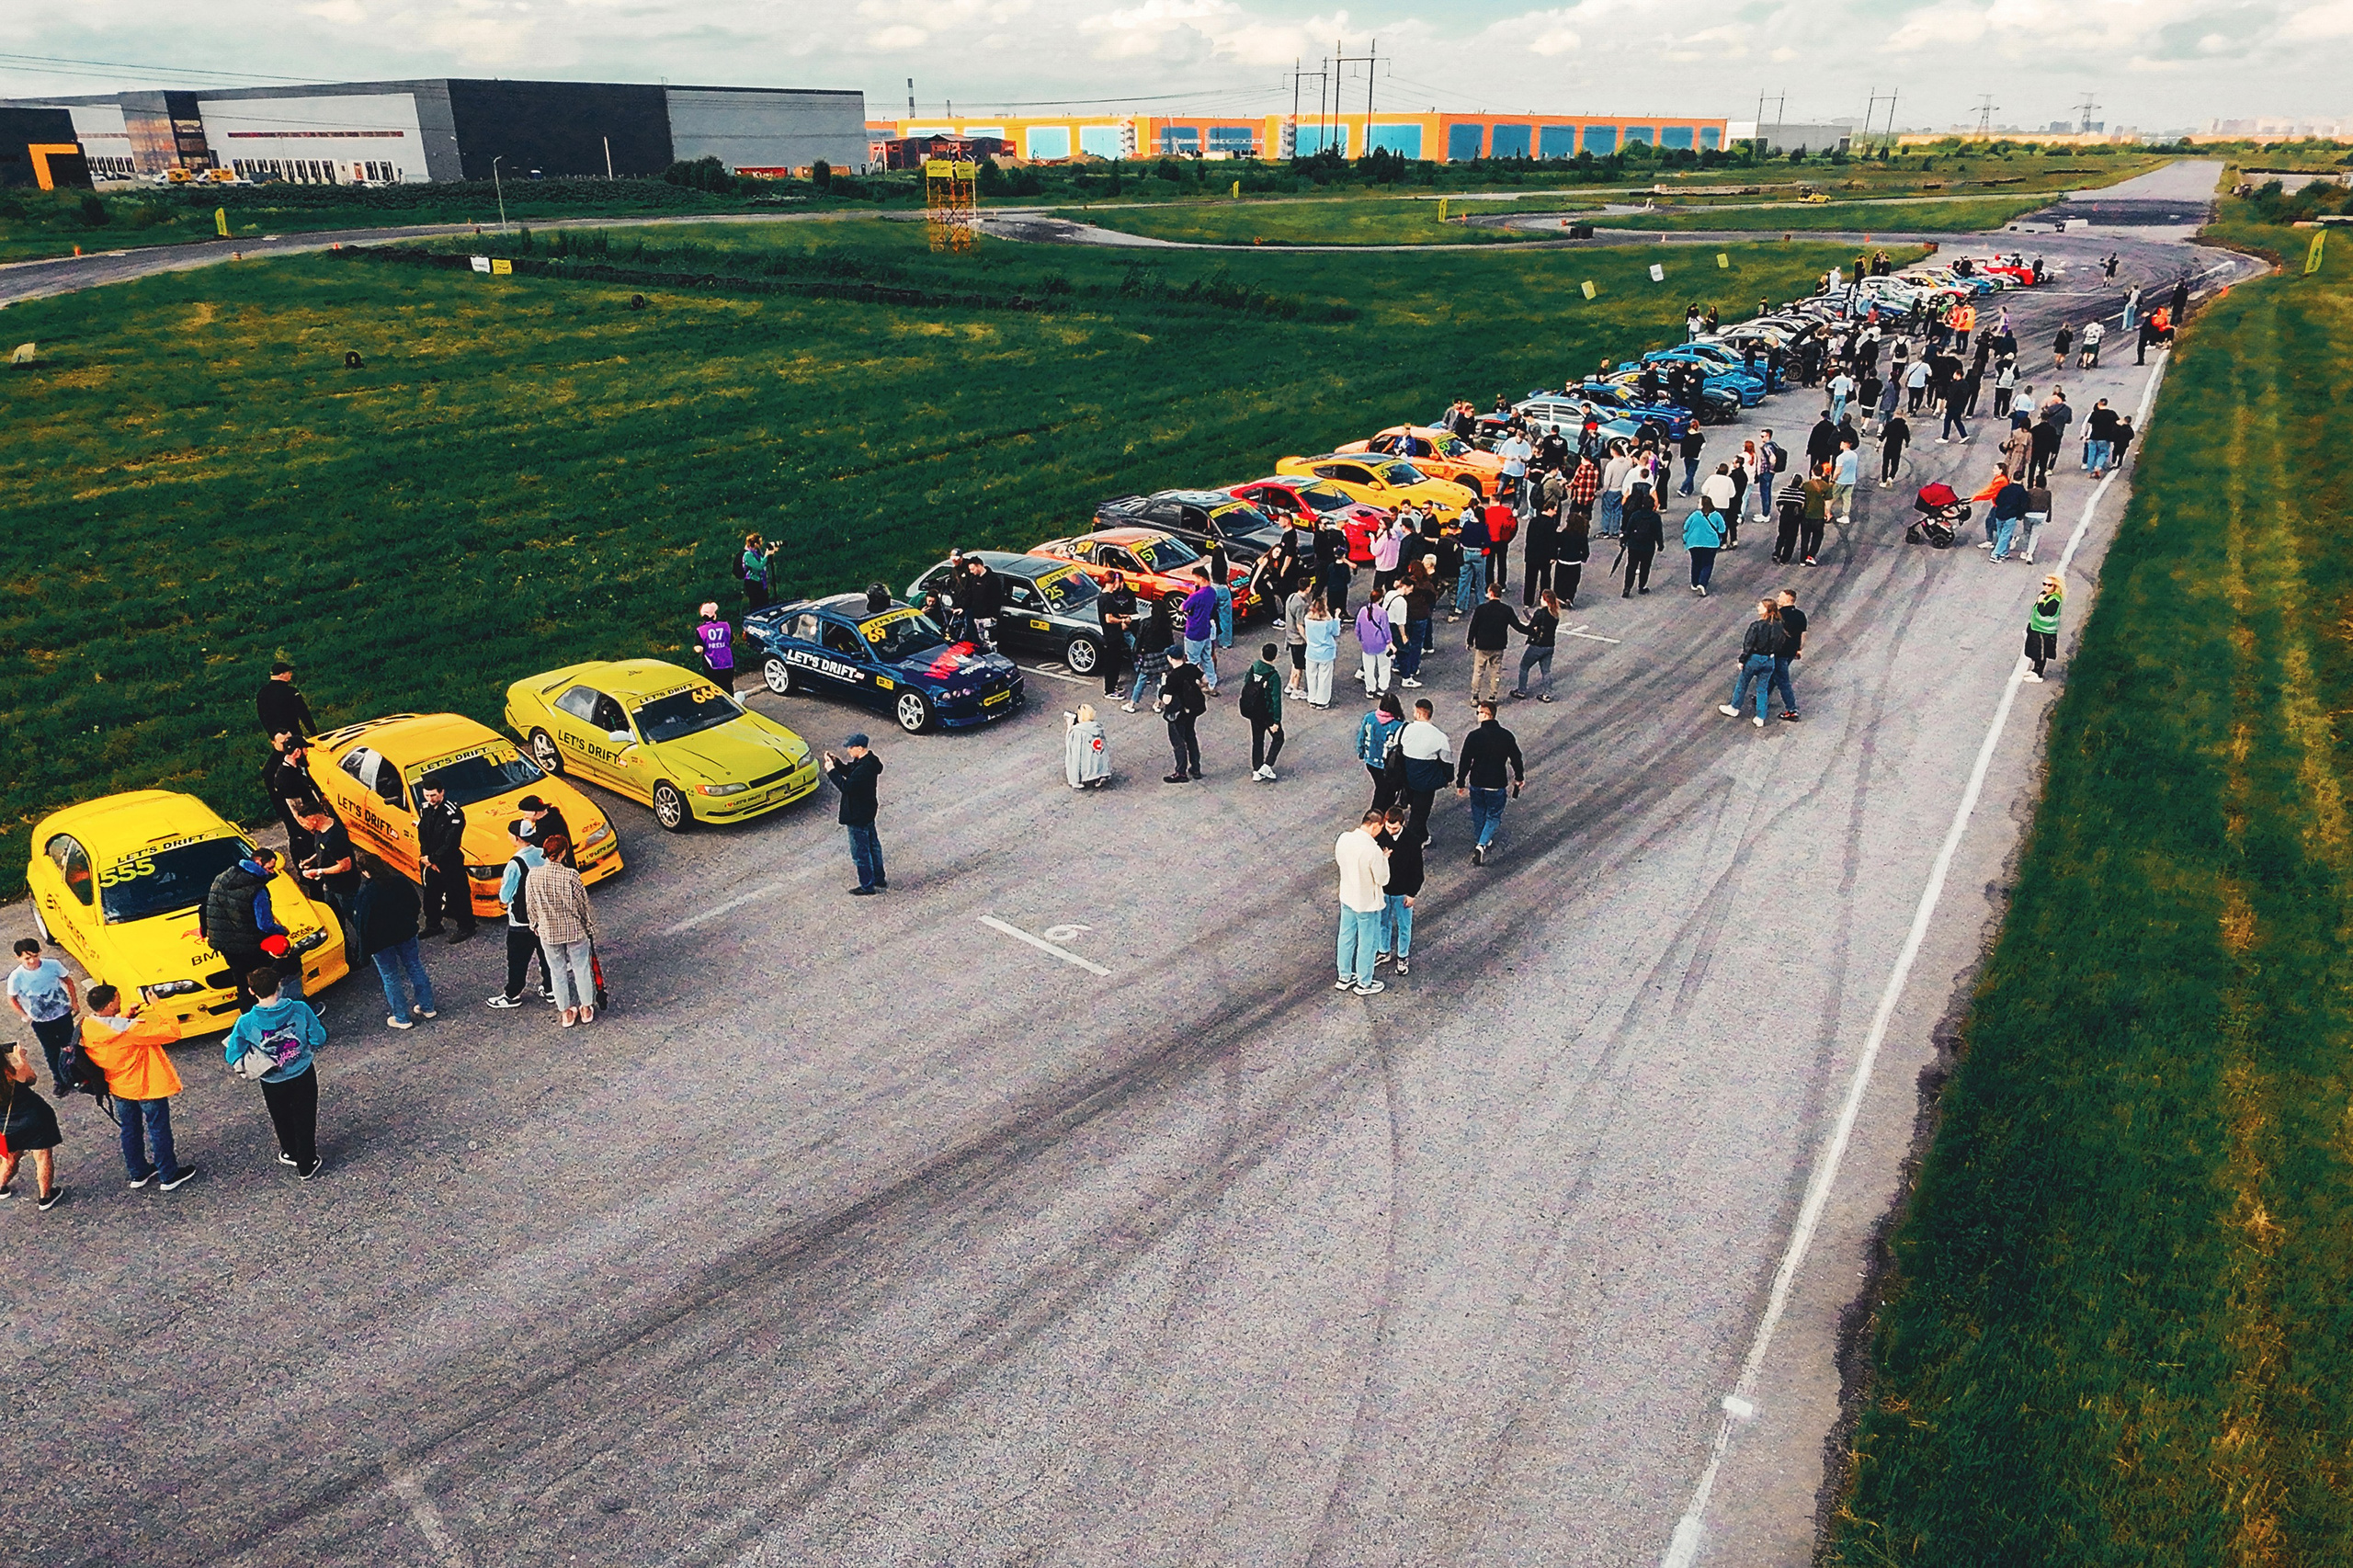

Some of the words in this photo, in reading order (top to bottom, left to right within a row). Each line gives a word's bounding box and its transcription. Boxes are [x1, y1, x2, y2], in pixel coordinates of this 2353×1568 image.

[1140, 548, 1155, 562] 57
[1044, 585, 1064, 600] 25
[870, 617, 891, 630] LET'S
[707, 628, 724, 641] 07
[867, 628, 887, 643] 69
[787, 649, 820, 668] LET'S
[820, 658, 858, 679] DRIFT
[639, 689, 665, 704] LET'S
[667, 683, 693, 697] DRIFT
[691, 685, 723, 704] 666
[558, 729, 585, 751] LET'S
[588, 741, 620, 765] DRIFT
[420, 756, 452, 773] LET'S
[454, 746, 488, 762] DRIFT
[483, 748, 520, 767] 118
[337, 793, 362, 818] LET'S
[364, 810, 392, 835] DRIFT
[117, 846, 157, 864] LET'S
[163, 834, 204, 850] DRIFT
[99, 857, 155, 888] 555
[191, 950, 222, 966] BM
